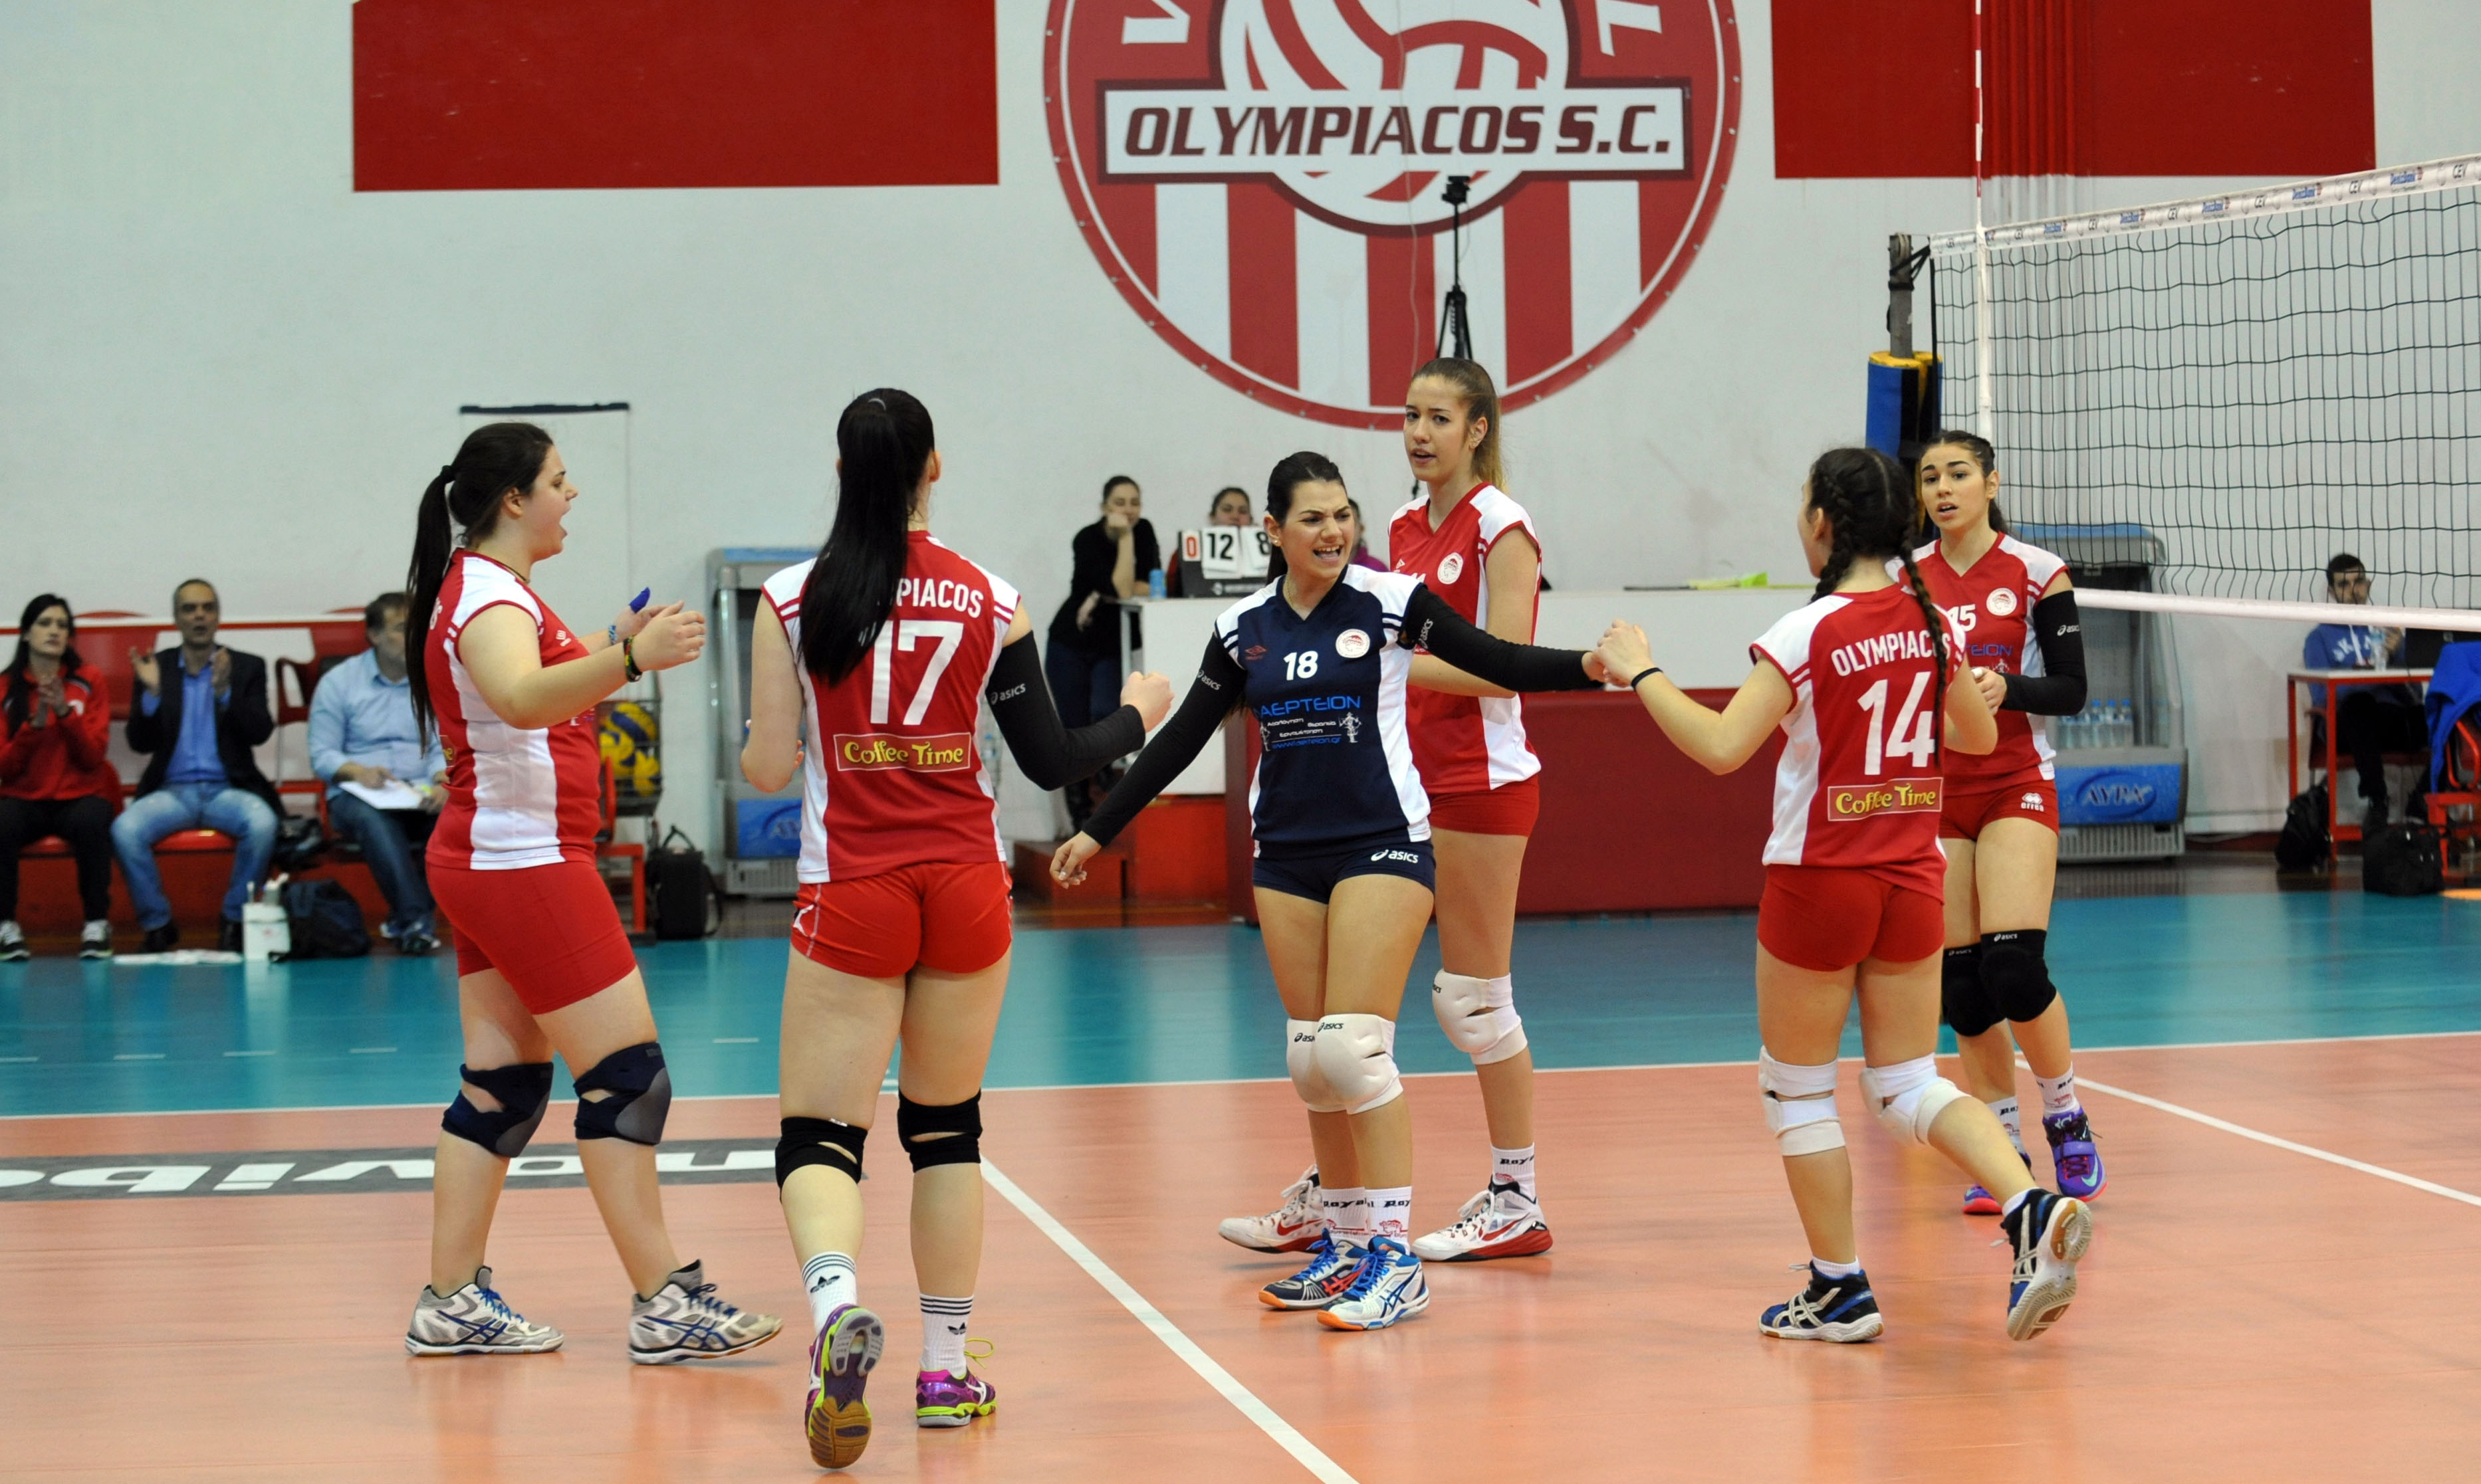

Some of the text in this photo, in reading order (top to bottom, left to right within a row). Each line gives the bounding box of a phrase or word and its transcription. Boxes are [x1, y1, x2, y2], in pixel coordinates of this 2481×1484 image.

[1125, 105, 1669, 157] OLYMPIACOS S.C.
[1187, 531, 1272, 560] 0 12 8
[896, 578, 984, 618] PIACOS
[1283, 651, 1318, 681] 18
[1831, 630, 1951, 677] OLYMPIACS
[870, 619, 964, 726] 17
[1201, 675, 1222, 690] asics
[999, 683, 1026, 700] asics
[1857, 671, 1935, 776] 14
[844, 740, 964, 766] Coffee Time
[1835, 783, 1937, 815] Coffee Time
[1388, 850, 1419, 864] asics
